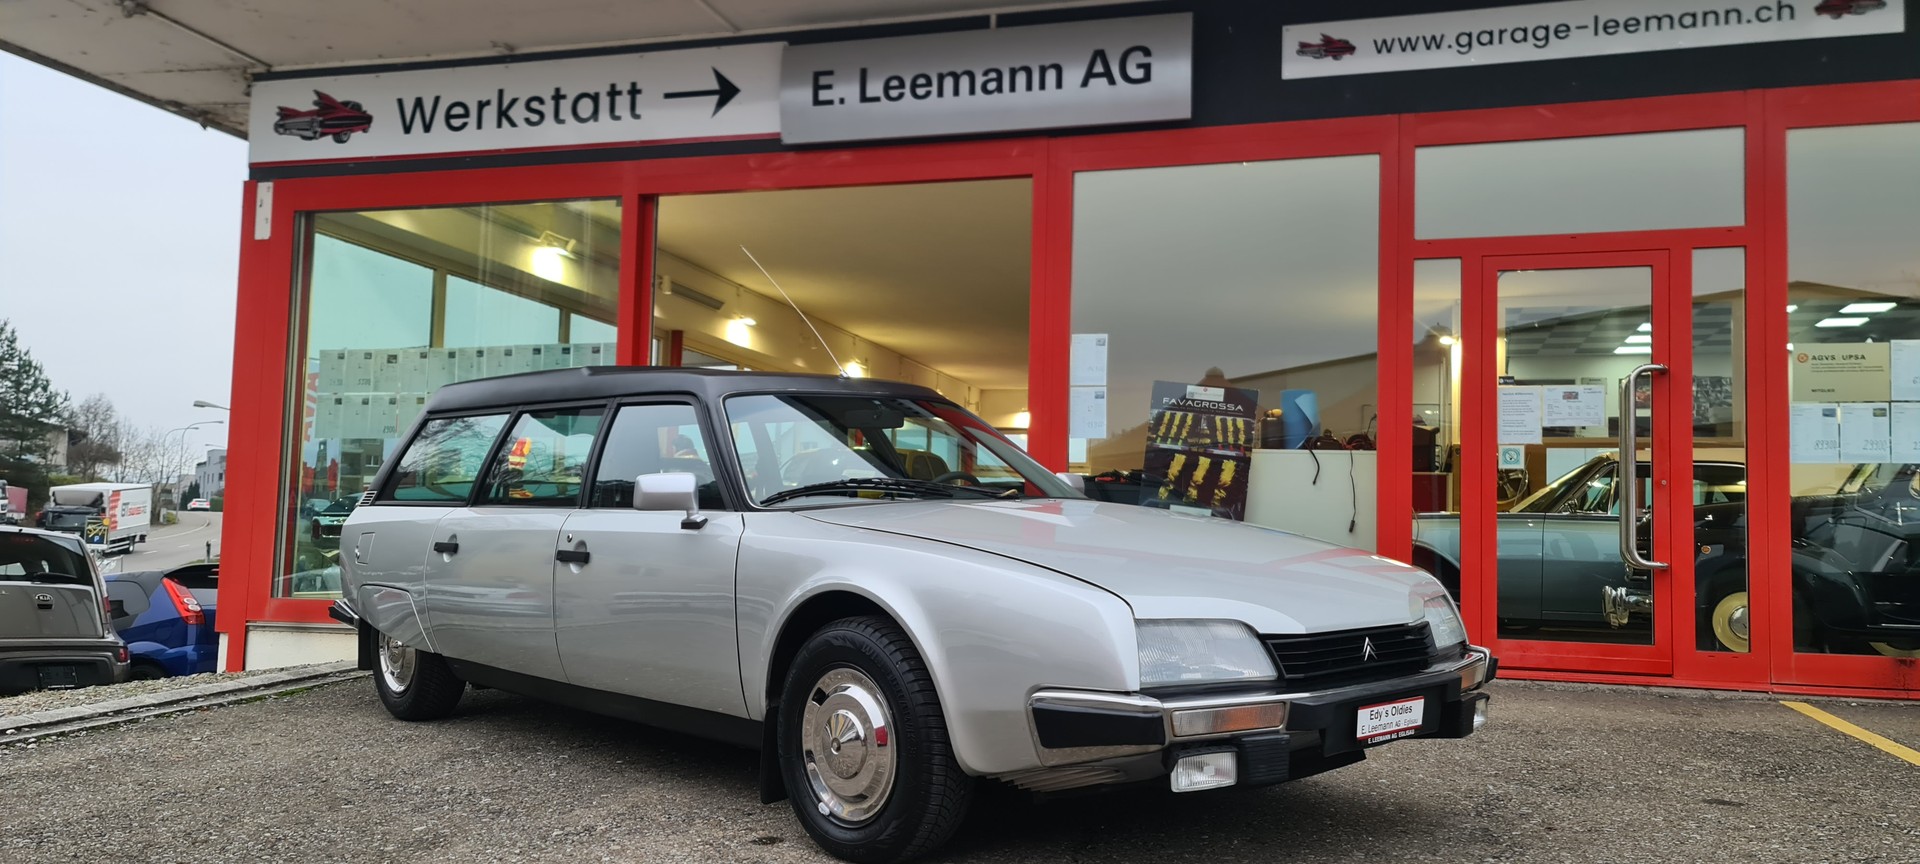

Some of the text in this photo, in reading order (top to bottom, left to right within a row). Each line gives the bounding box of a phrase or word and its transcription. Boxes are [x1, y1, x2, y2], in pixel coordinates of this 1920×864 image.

[1373, 1, 1796, 55] www.garage-leemann.ch
[811, 44, 1153, 107] E. Leemann AG
[395, 81, 643, 135] Werkstatt
[1841, 353, 1866, 361] UPSA
[1162, 397, 1244, 412] FAVAGROSSA
[1391, 705, 1412, 715] Oldies
[1368, 721, 1393, 734] Leemann
[1395, 719, 1401, 727] AG
